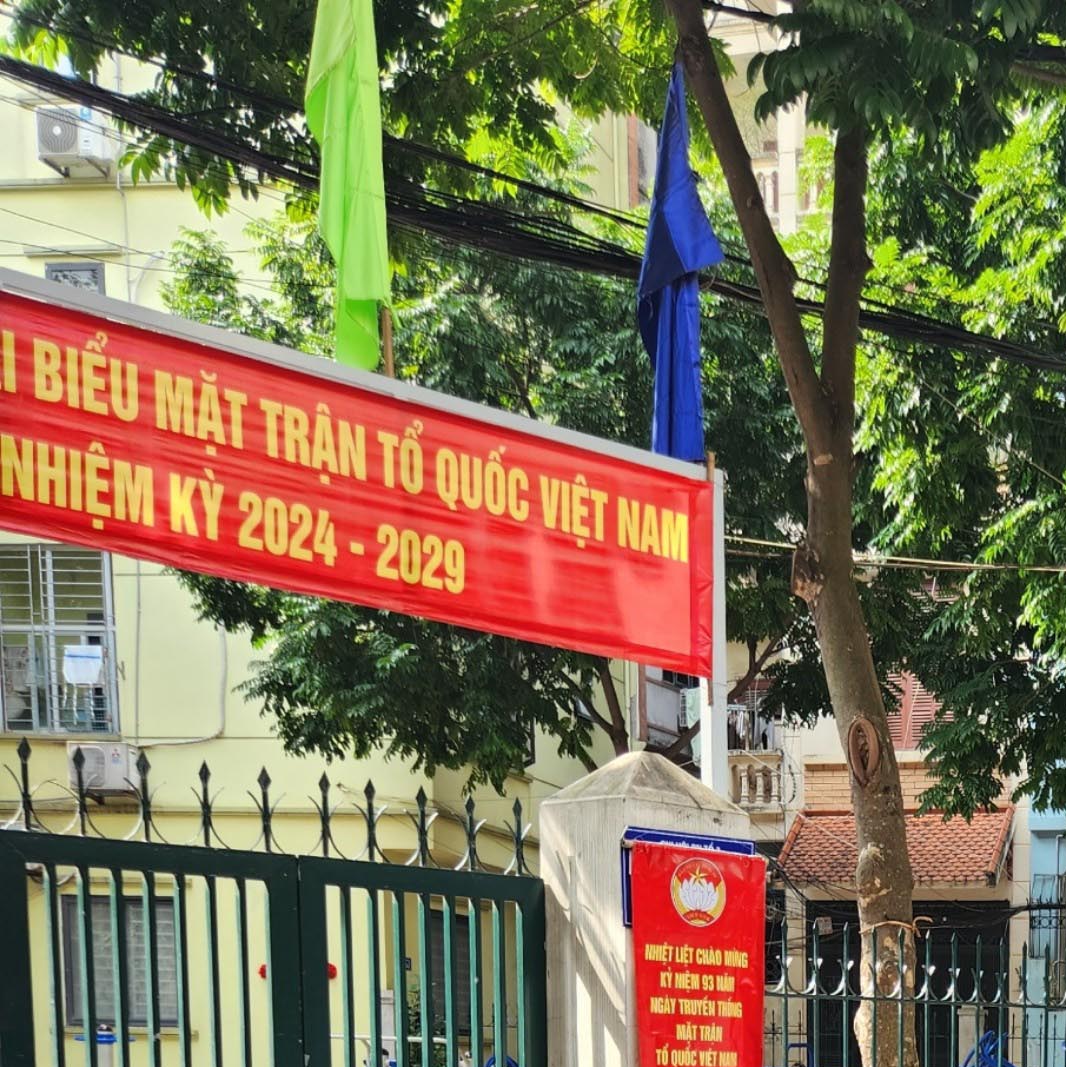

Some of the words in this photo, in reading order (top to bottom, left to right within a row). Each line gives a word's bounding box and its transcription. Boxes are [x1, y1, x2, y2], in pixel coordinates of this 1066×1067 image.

[33, 331, 140, 422] BIỂU
[155, 369, 248, 456] MẶT
[260, 402, 367, 485] TRẬN
[377, 419, 424, 495] TỔ
[436, 446, 530, 522] QUỐC
[539, 474, 609, 549] VIỆT
[617, 496, 689, 563] NAM
[0, 433, 155, 530] NHIỆM
[169, 468, 225, 541] KỲ
[238, 491, 338, 567] 2024
[350, 541, 365, 556] -
[376, 523, 465, 595] 2029
[645, 942, 674, 966] NHIỆT
[675, 944, 694, 967] LIỆT
[695, 946, 722, 966] CHÀO
[724, 947, 749, 968] MỪNG
[660, 966, 672, 988] KỶ
[675, 970, 700, 993] NIỆM
[702, 974, 714, 991] 93
[716, 972, 735, 992] NĂM
[650, 994, 676, 1014] NGÀY
[717, 996, 742, 1018] THỐNG
[676, 1021, 697, 1044] MẶT
[699, 1022, 723, 1045] TRẬN
[671, 1044, 697, 1067] QUỐC
[719, 1051, 737, 1067] NAM
